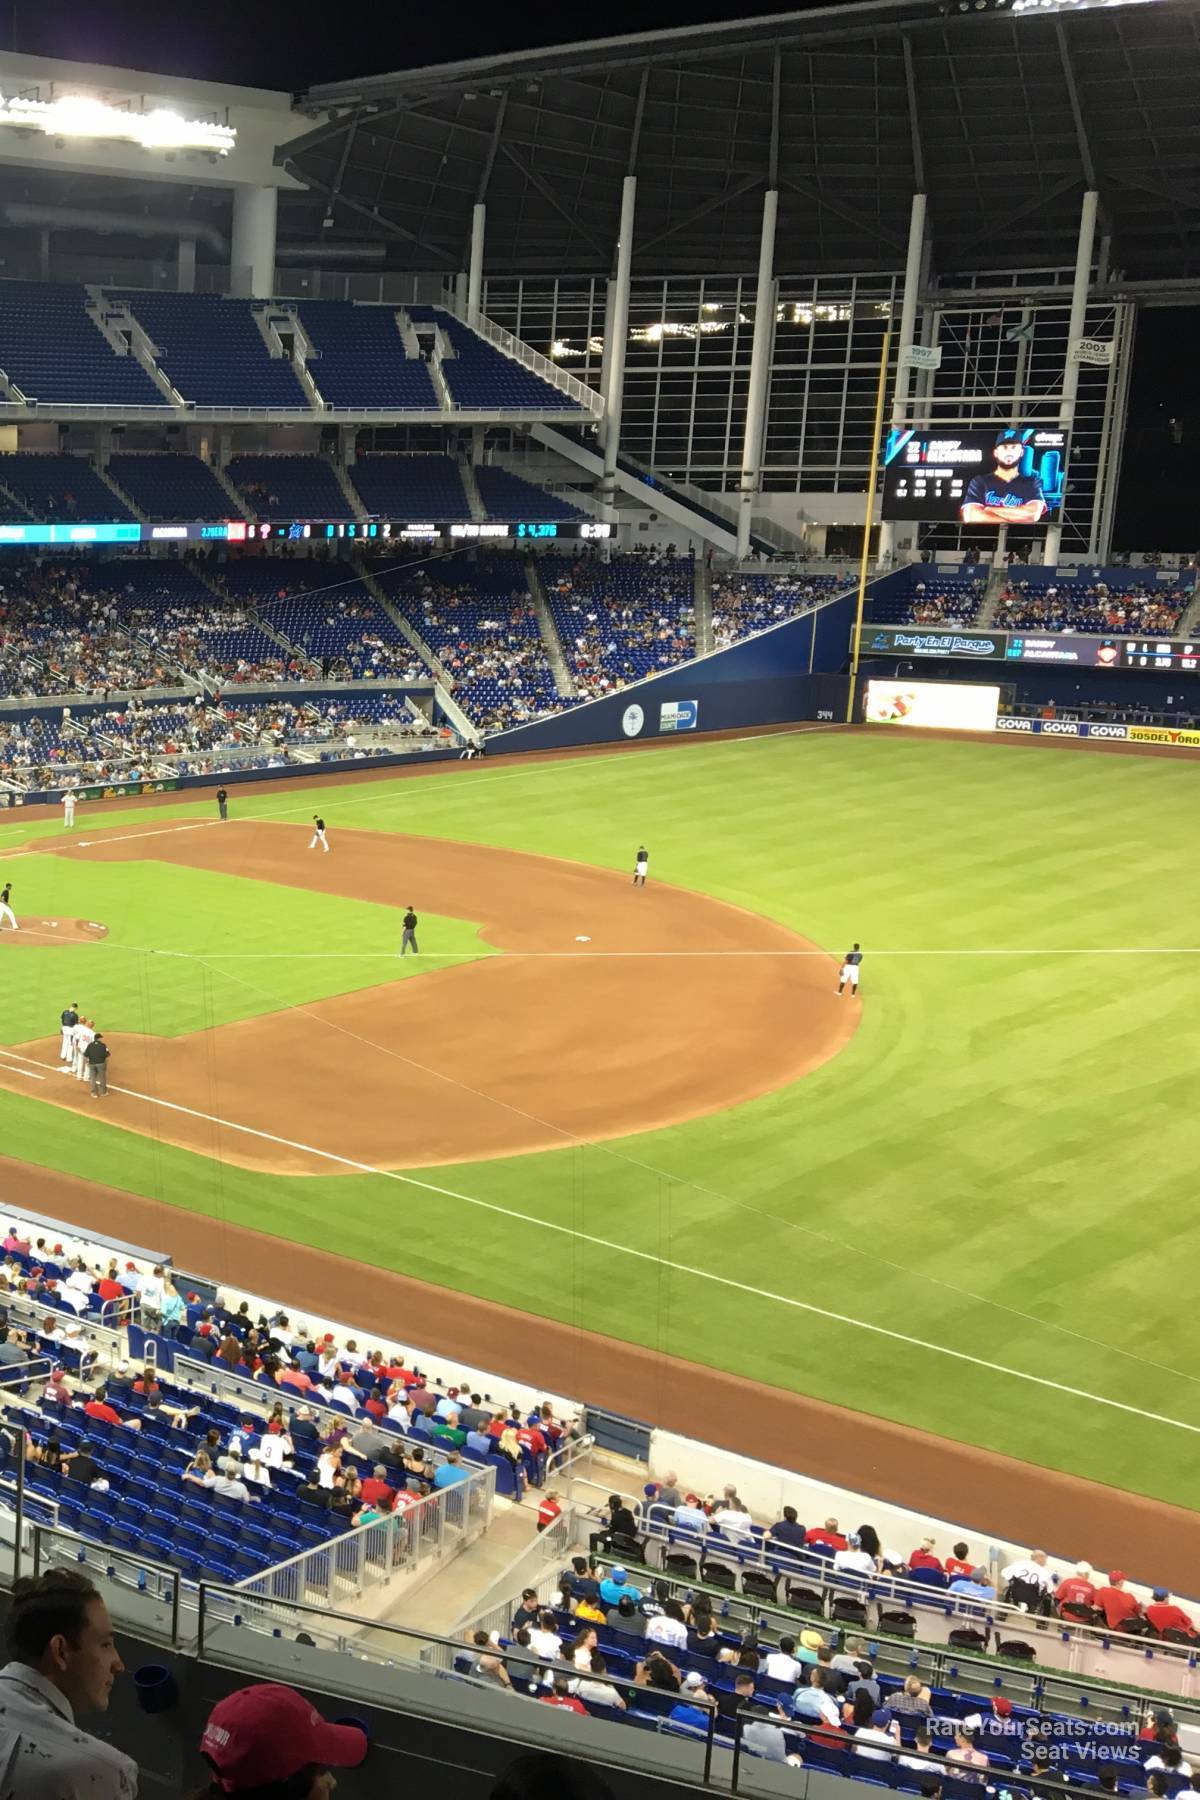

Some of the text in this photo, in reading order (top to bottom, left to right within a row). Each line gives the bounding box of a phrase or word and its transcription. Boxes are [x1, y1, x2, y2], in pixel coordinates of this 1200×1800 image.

[1079, 341, 1106, 353] 2003
[894, 634, 994, 651] Party En El Parque
[816, 710, 834, 720] 344
[997, 718, 1032, 730] GOYA
[1043, 722, 1078, 734] GOYA
[1090, 725, 1127, 738] GOYA
[265, 1446, 273, 1458] 3
[1020, 1568, 1040, 1585] 20
